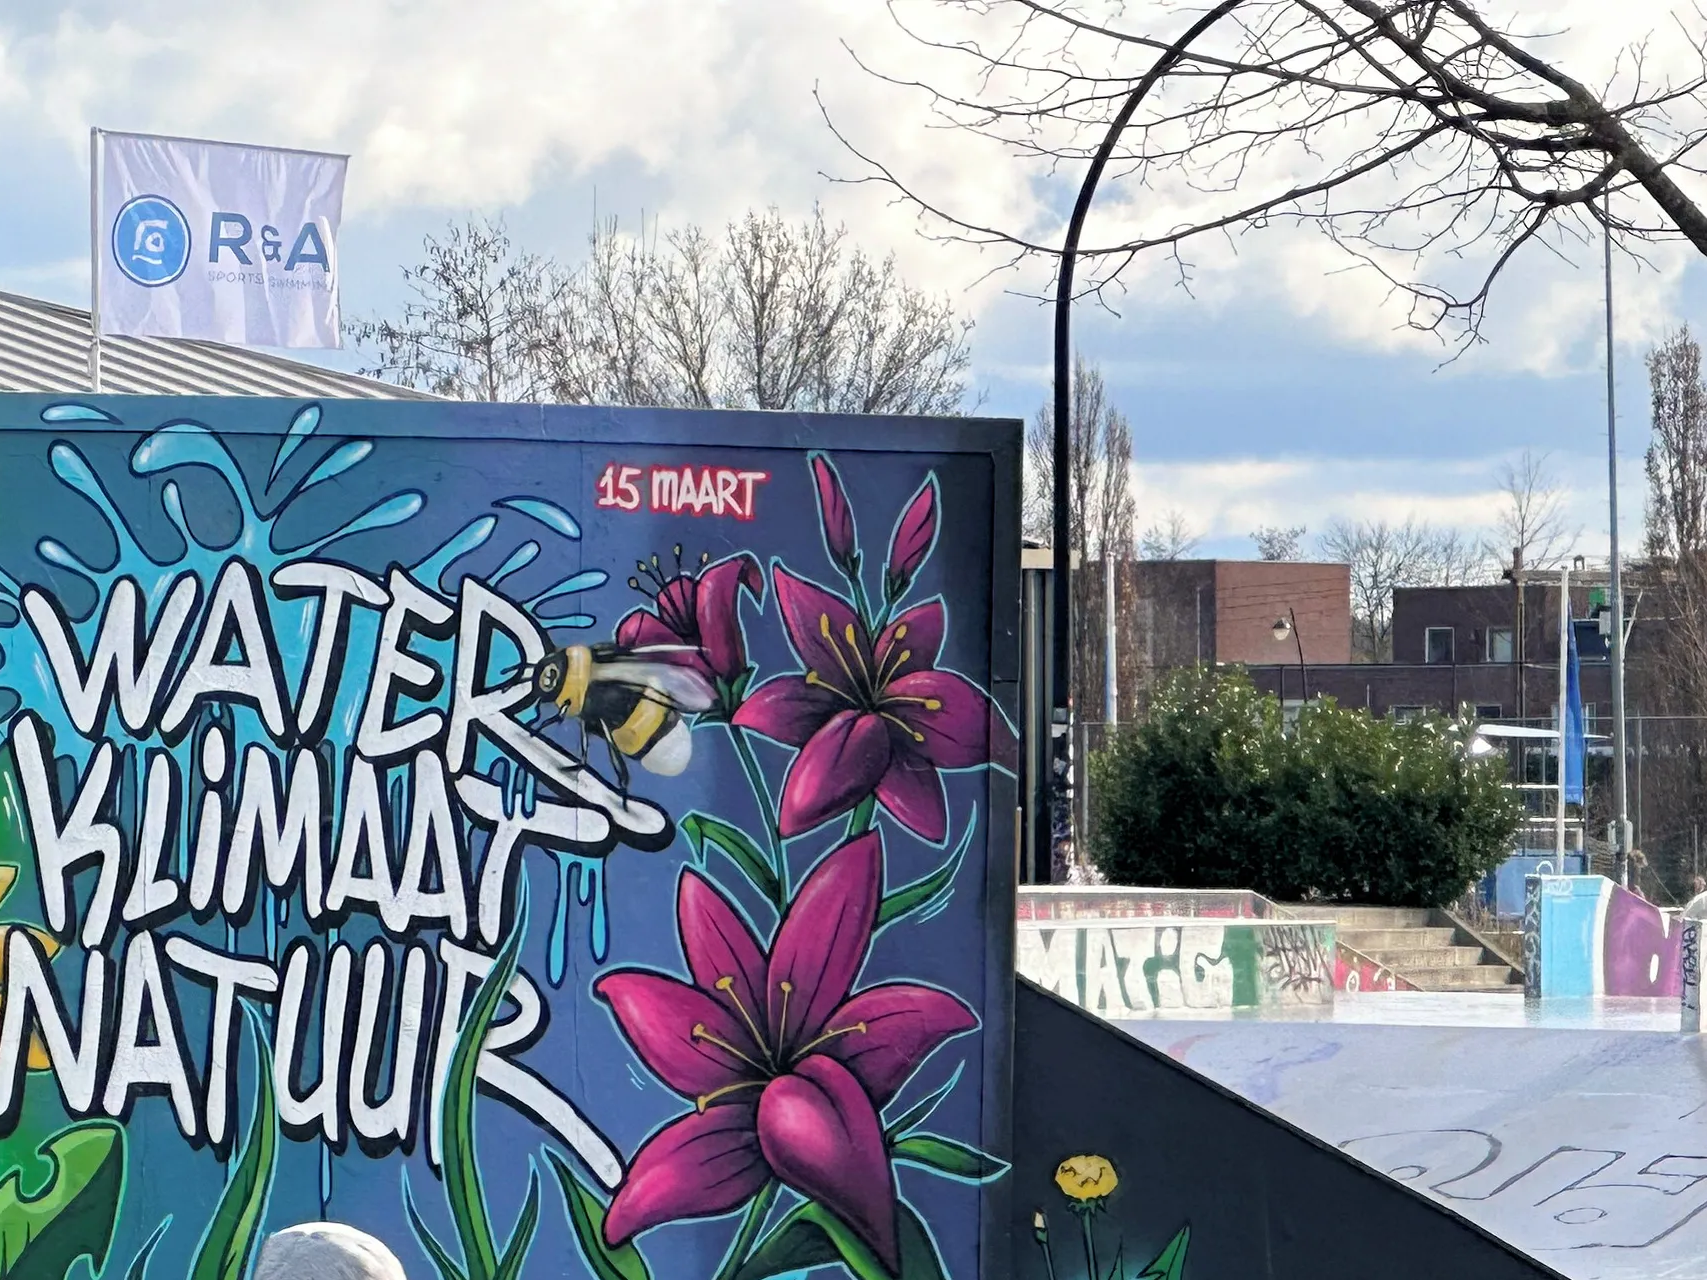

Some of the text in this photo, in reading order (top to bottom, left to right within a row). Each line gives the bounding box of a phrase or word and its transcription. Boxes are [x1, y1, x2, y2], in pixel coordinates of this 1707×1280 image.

[208, 211, 331, 273] R&A
[597, 464, 768, 517] 15 MAART
[21, 560, 669, 836] WATER
